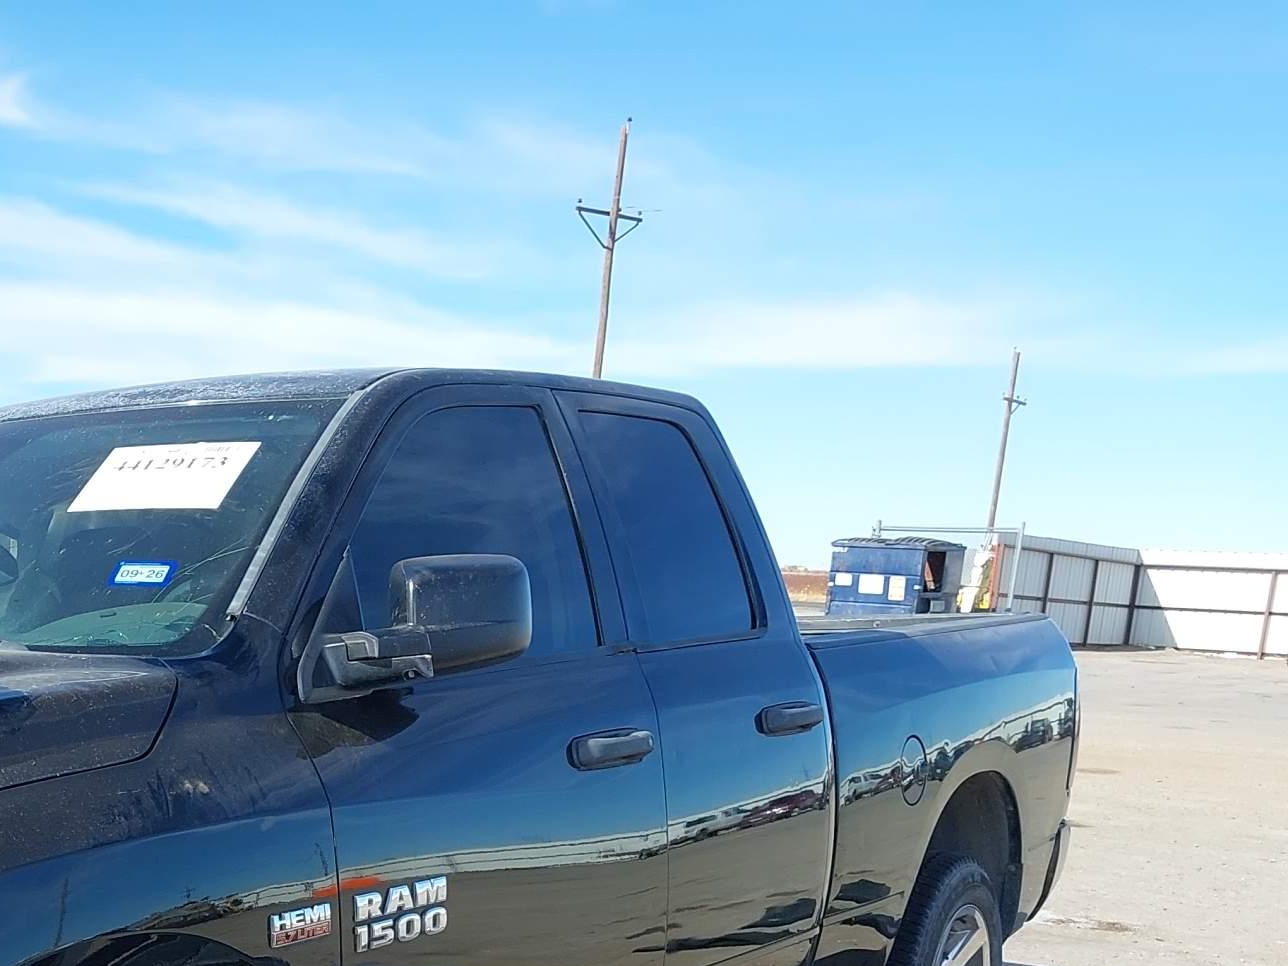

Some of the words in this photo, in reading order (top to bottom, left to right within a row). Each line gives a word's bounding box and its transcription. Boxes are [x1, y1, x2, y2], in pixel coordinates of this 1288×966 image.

[270, 902, 331, 932] HEMI
[353, 875, 448, 922] RAM
[275, 930, 298, 946] 5.7
[298, 926, 330, 940] LITER
[353, 906, 449, 954] 1500
